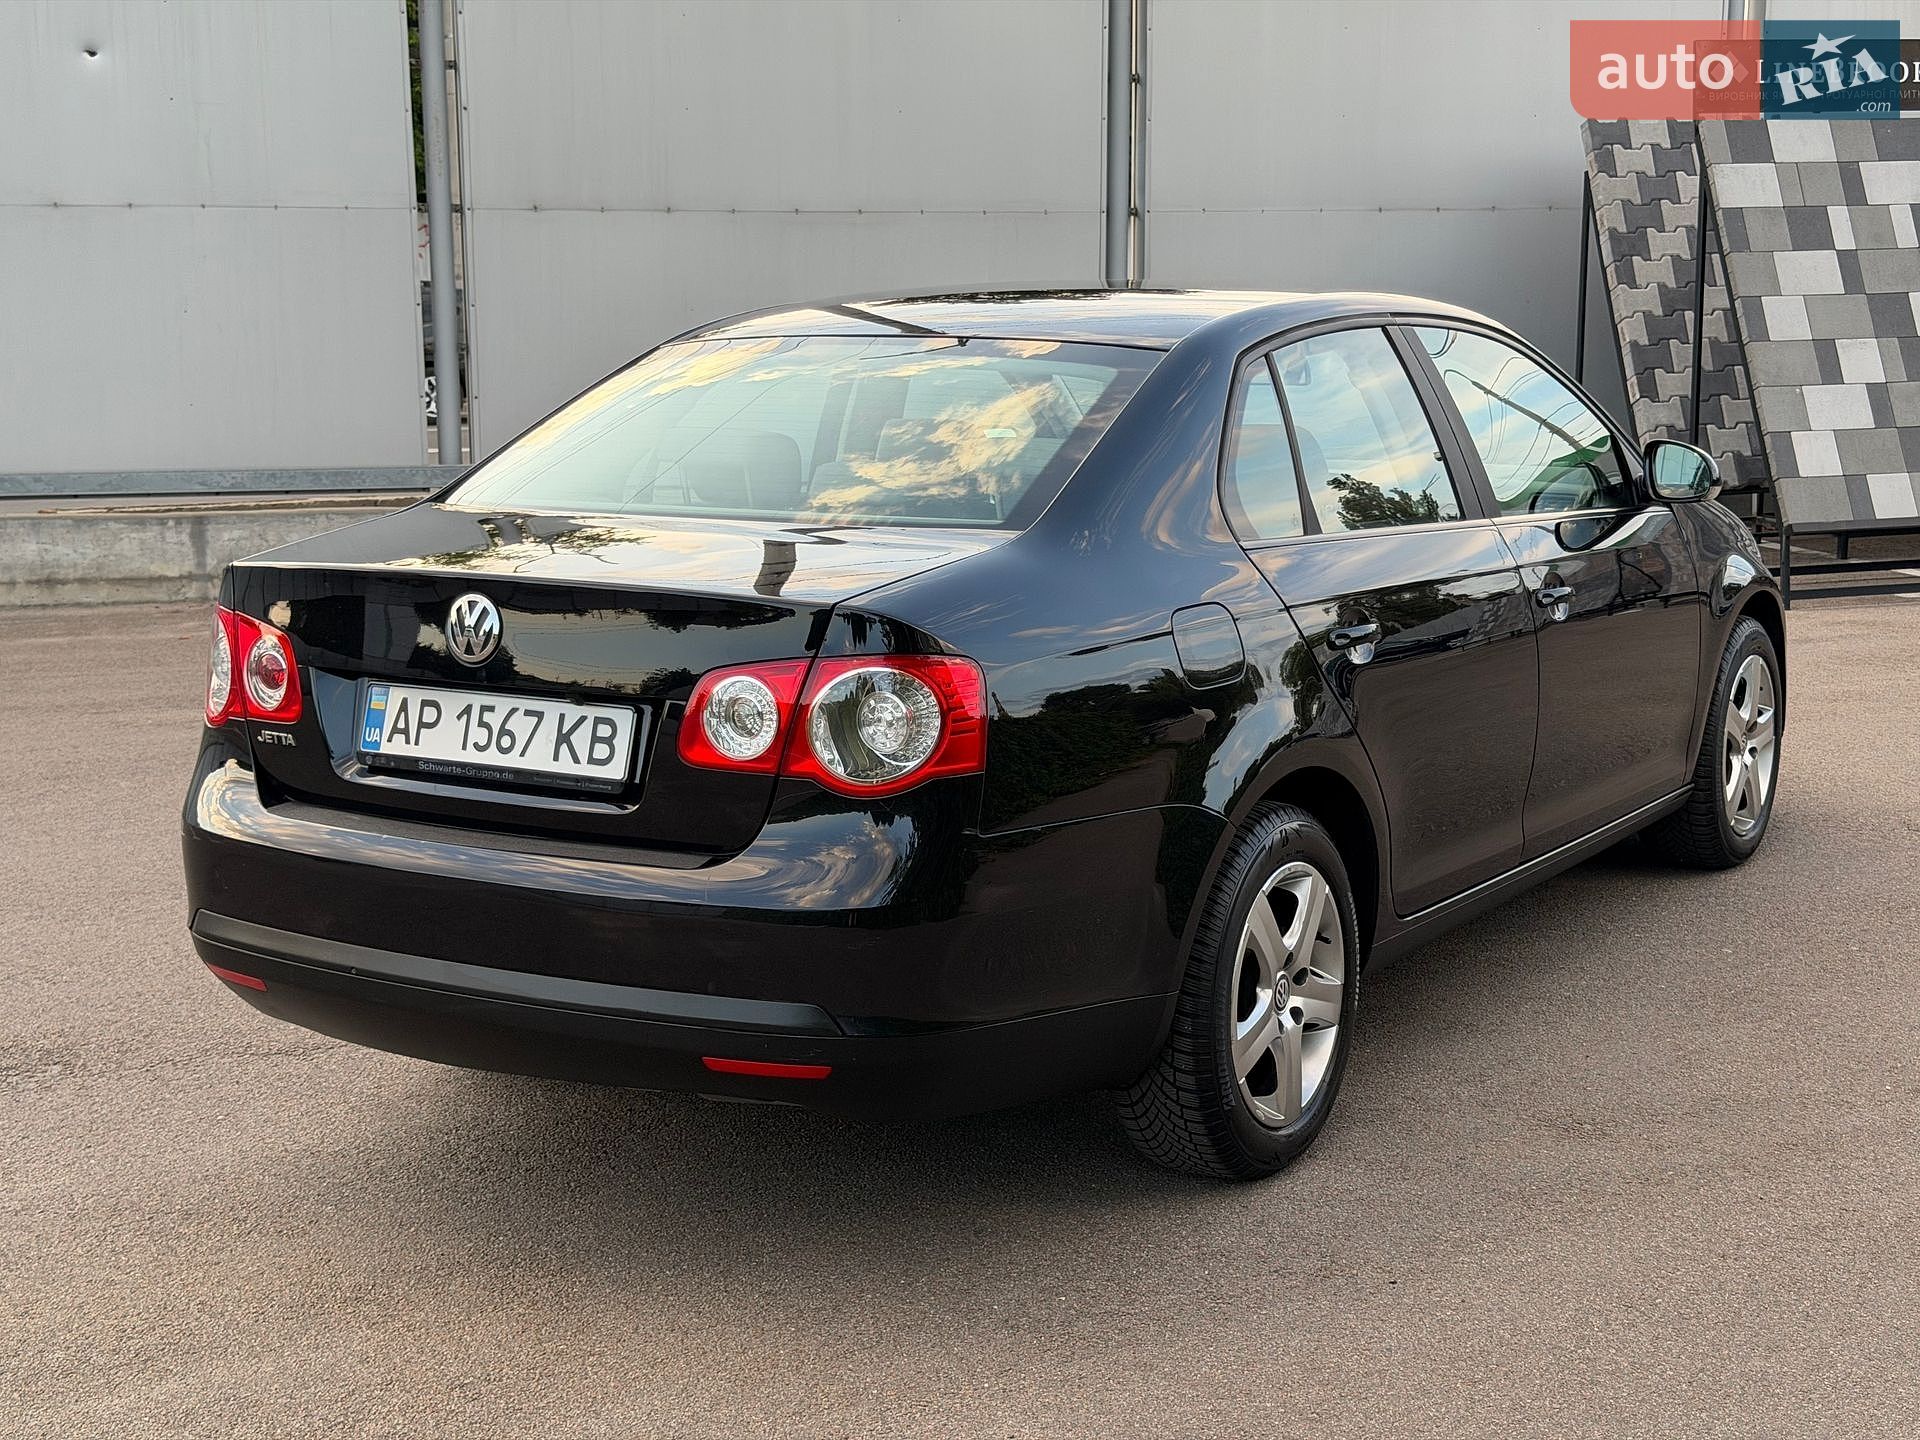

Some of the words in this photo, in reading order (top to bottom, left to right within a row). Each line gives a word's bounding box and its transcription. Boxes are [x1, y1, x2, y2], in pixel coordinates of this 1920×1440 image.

[256, 729, 297, 747] JETTA
[365, 726, 381, 743] UA
[386, 696, 443, 746] AP
[456, 703, 545, 758] 1567
[552, 712, 618, 767] KB
